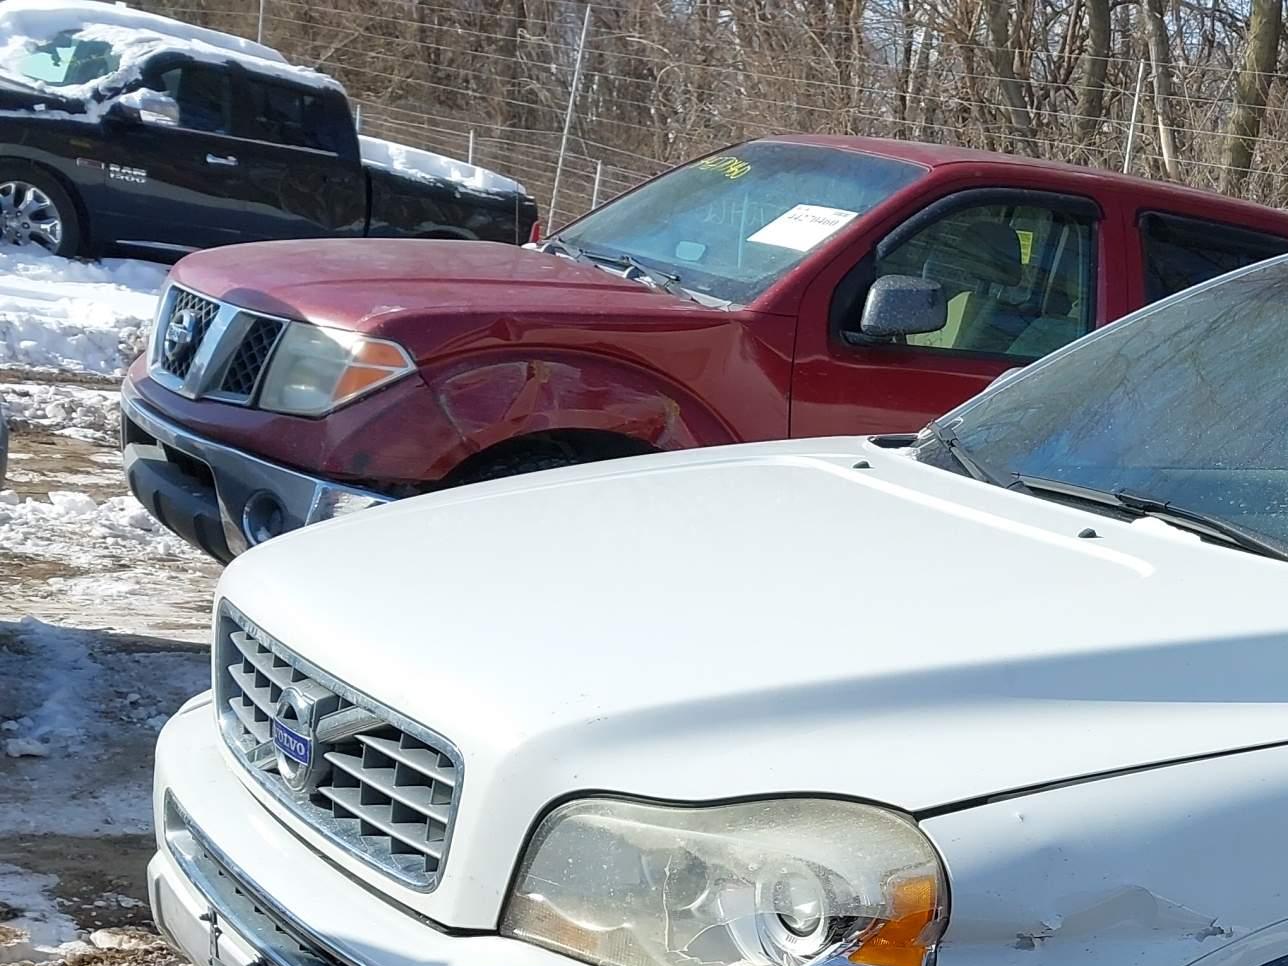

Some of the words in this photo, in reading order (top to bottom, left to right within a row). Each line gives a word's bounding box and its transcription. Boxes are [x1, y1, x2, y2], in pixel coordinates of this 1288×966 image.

[109, 163, 147, 177] RAM
[109, 172, 147, 184] 1500
[274, 727, 306, 756] VOLVO
